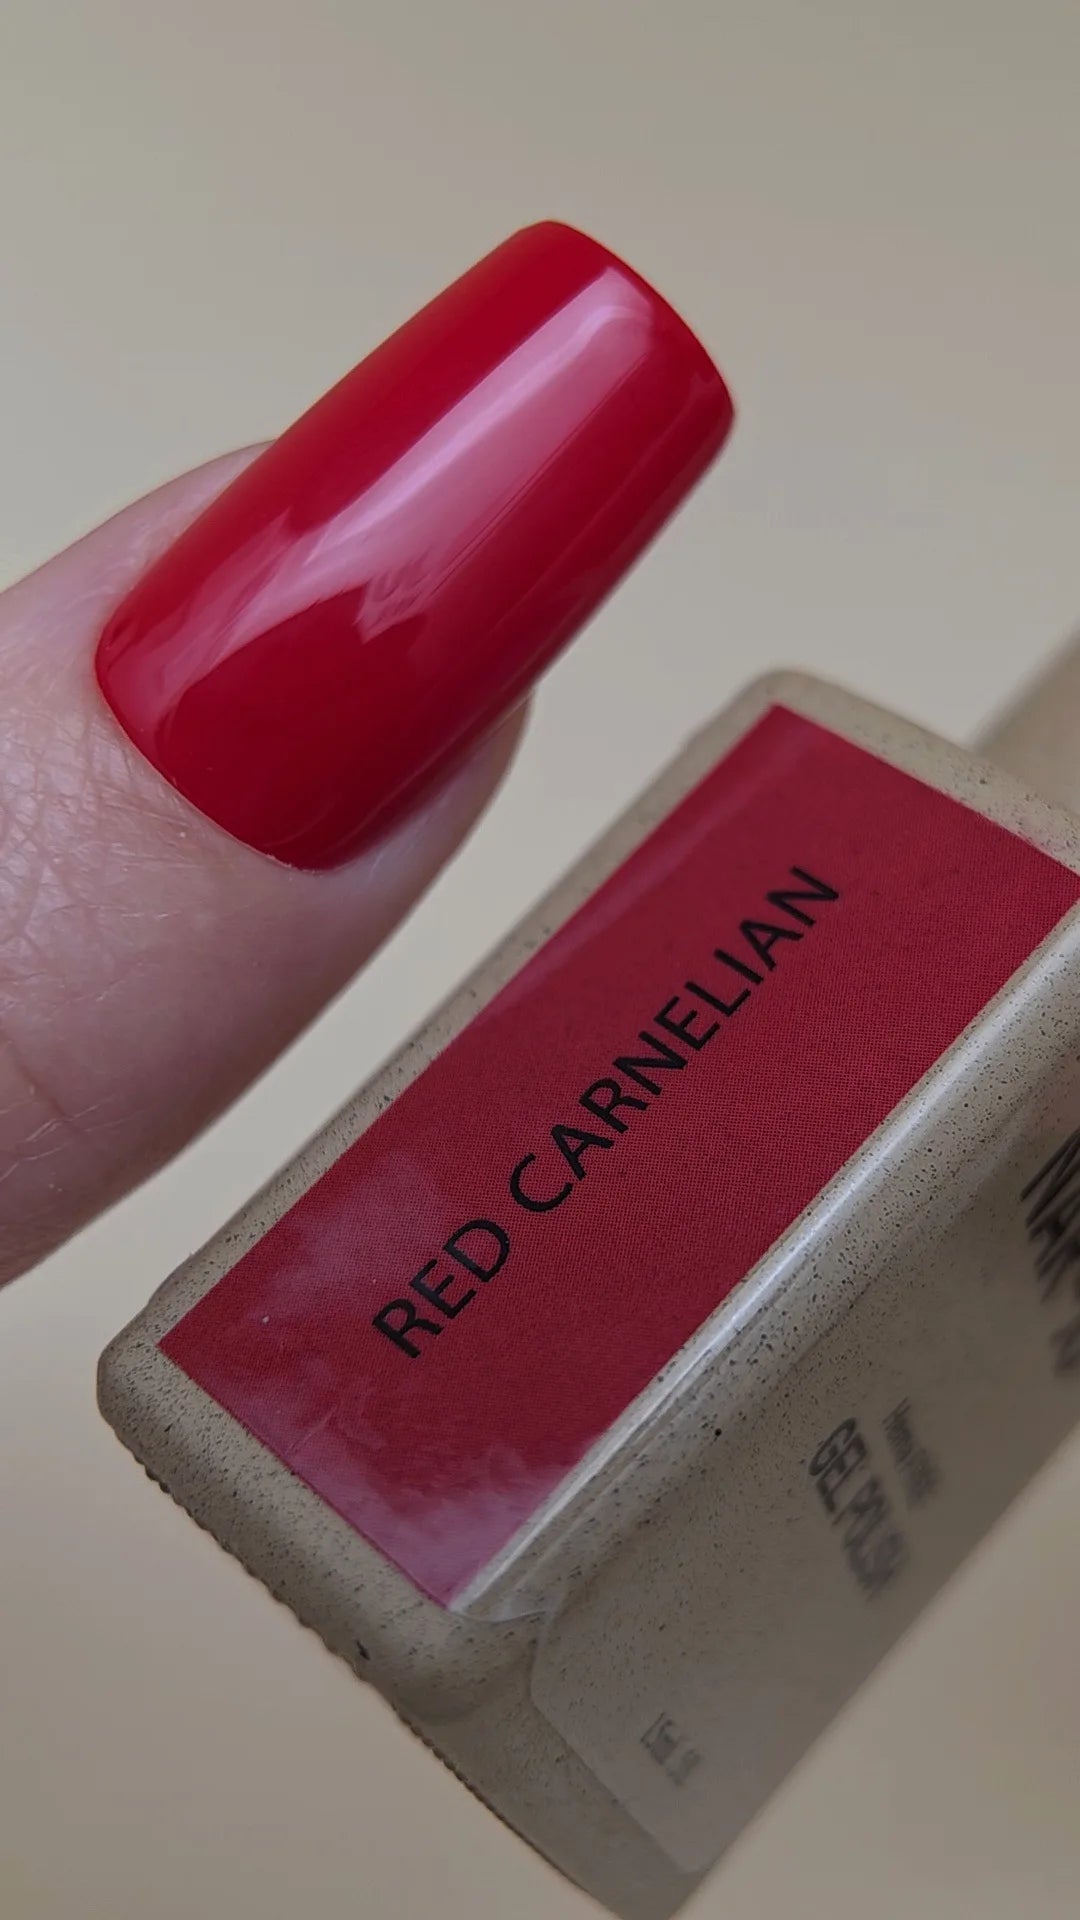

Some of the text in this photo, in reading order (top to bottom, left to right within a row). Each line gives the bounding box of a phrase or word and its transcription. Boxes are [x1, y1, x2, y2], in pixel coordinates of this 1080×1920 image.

[371, 865, 840, 1360] RED CARNELIAN
[808, 1417, 868, 1514] GEL
